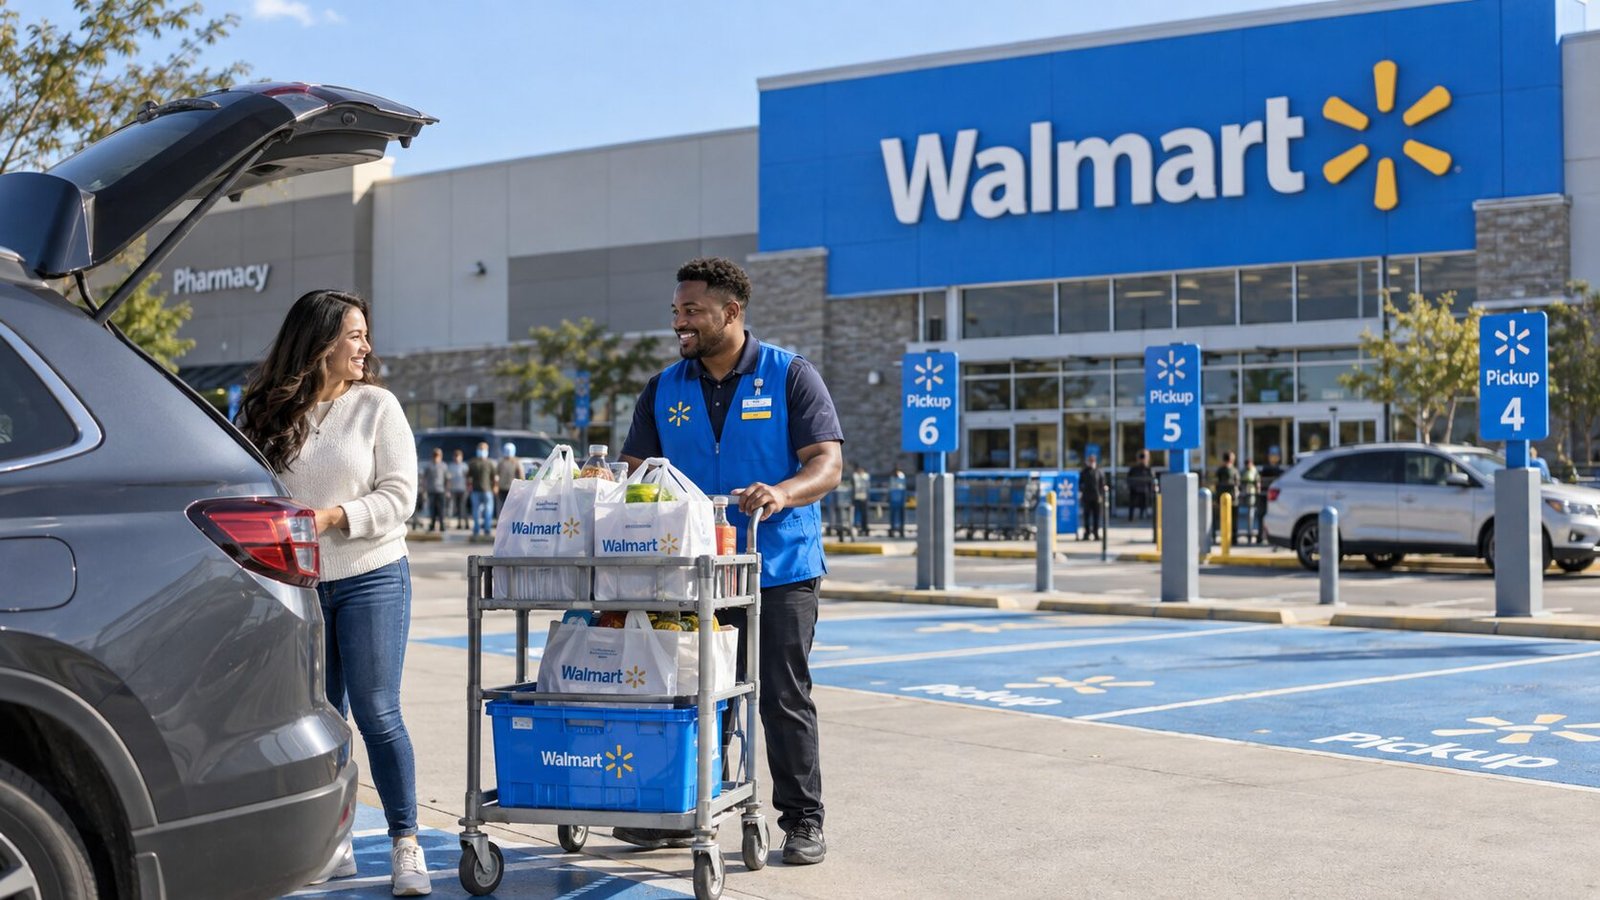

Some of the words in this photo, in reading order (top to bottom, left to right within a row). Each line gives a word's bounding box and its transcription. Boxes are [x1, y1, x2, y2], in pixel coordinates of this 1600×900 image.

[880, 96, 1304, 224] Walmart
[173, 263, 269, 295] Pharmacy
[1486, 369, 1540, 388] Pickup
[907, 393, 951, 411] Pickup
[1150, 389, 1194, 407] Pickup
[1500, 397, 1525, 431] 4
[919, 416, 939, 445] 6
[1163, 413, 1182, 442] 5
[512, 521, 562, 536] Walmart
[602, 538, 658, 553] Walmart
[561, 664, 623, 685] Walmart
[541, 750, 603, 769] Walmart
[1309, 732, 1559, 769] Pickup
